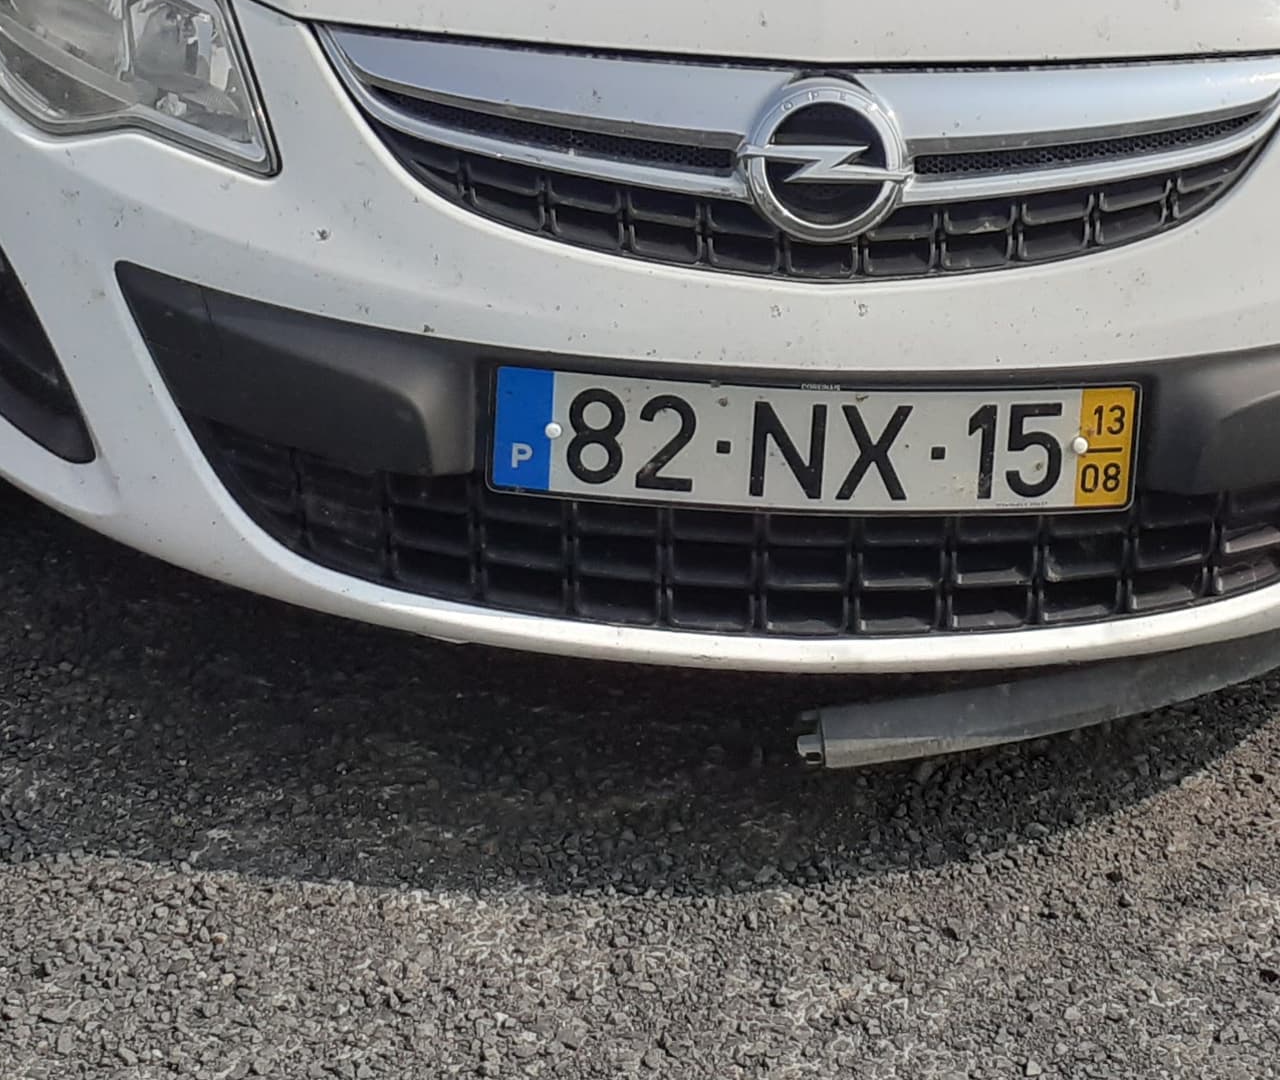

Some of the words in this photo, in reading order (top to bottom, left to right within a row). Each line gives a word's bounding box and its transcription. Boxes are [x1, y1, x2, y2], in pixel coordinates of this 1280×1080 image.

[511, 442, 534, 469] P
[1093, 404, 1126, 436] 13
[1080, 462, 1121, 494] 08
